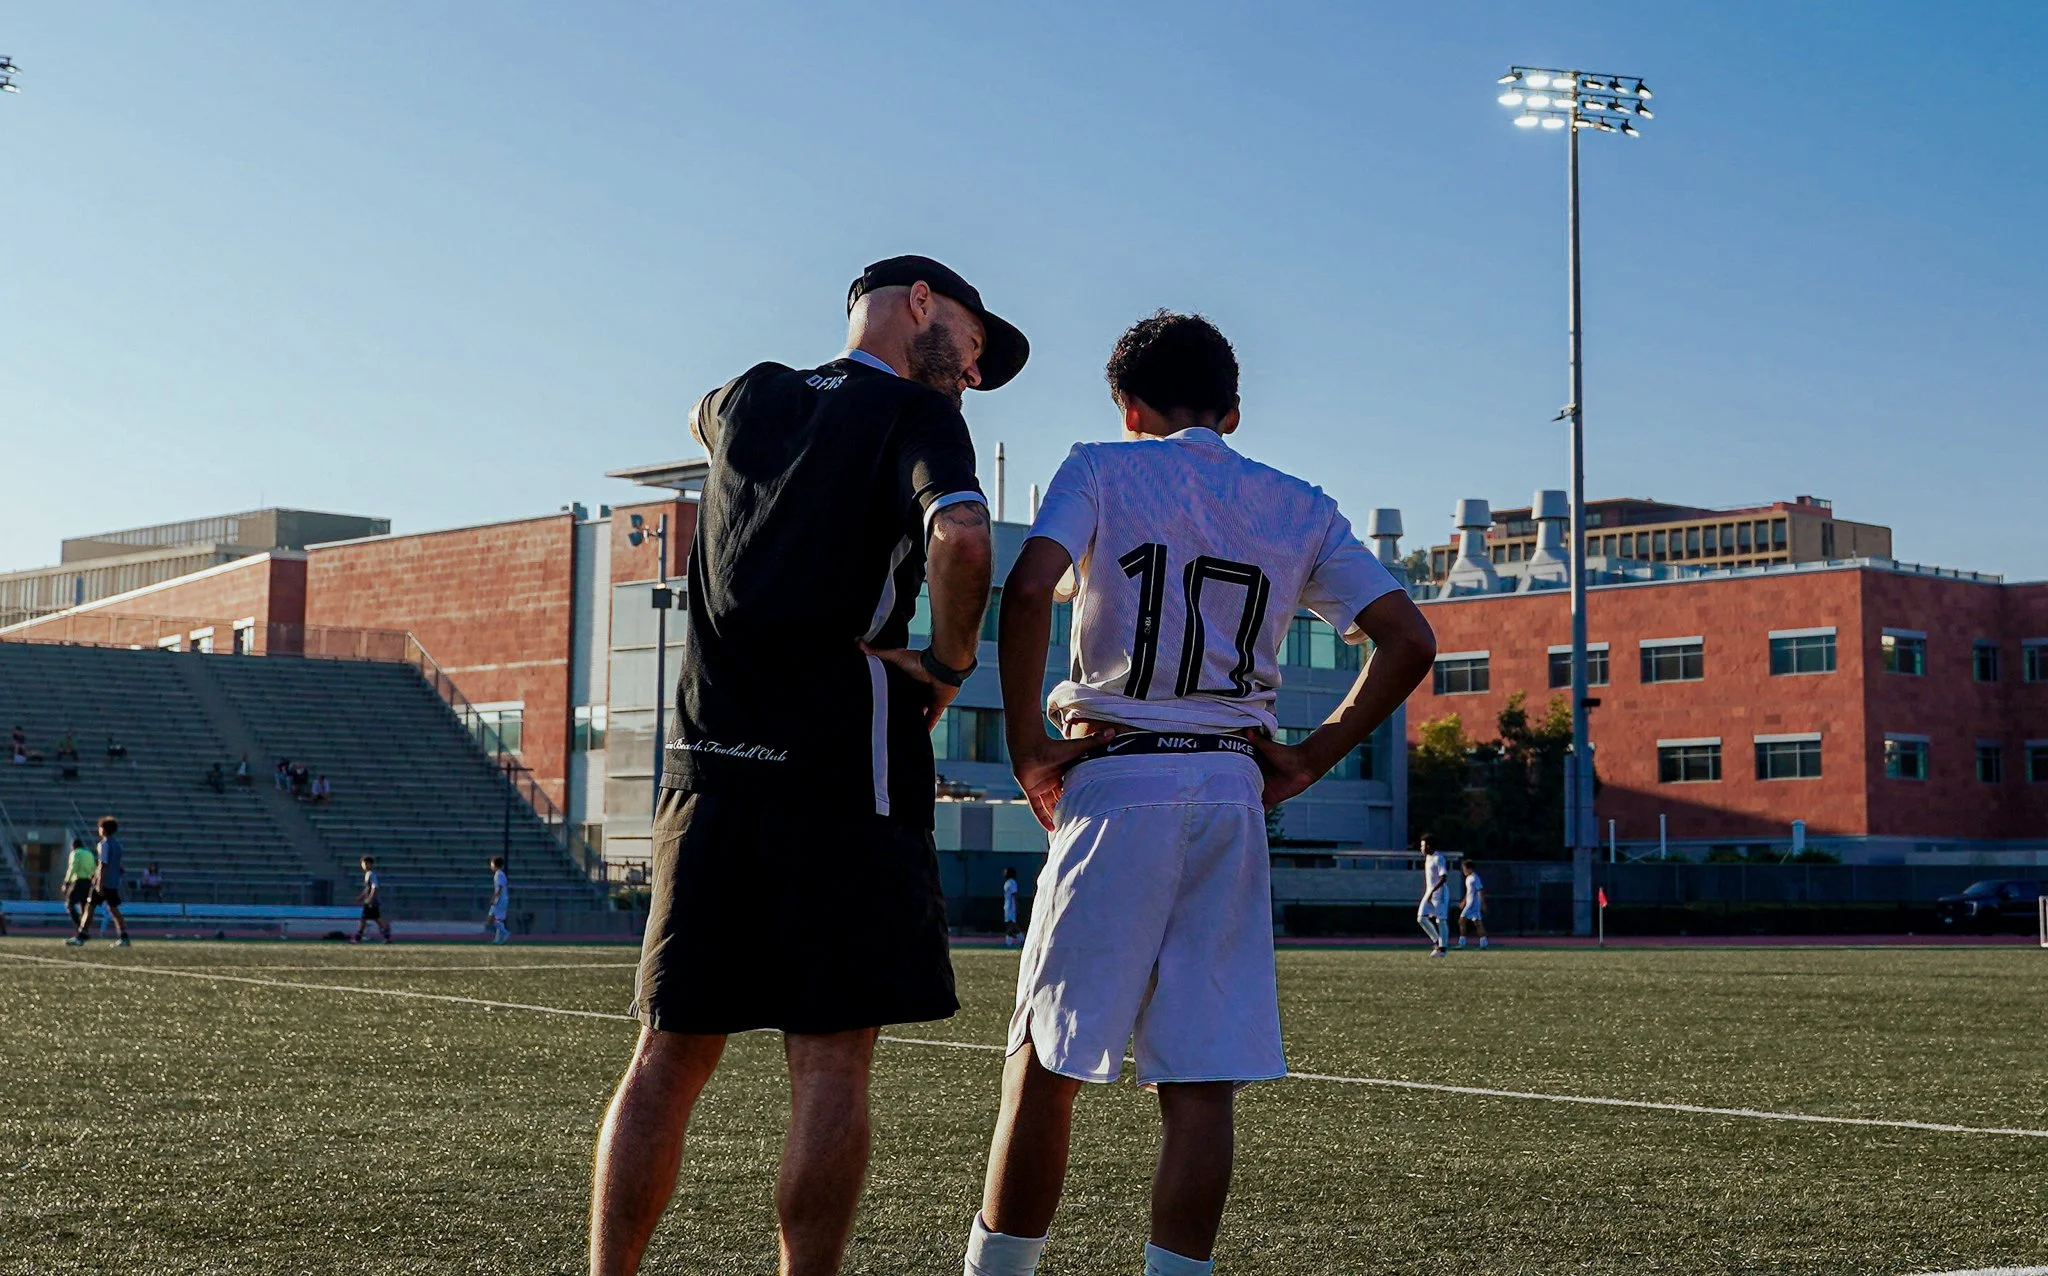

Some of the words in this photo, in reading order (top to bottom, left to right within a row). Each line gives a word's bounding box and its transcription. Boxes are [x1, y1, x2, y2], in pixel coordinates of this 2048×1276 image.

[1117, 542, 1271, 700] 10
[704, 740, 761, 759] Football
[757, 746, 788, 762] Club
[1218, 739, 1255, 756] NIKE
